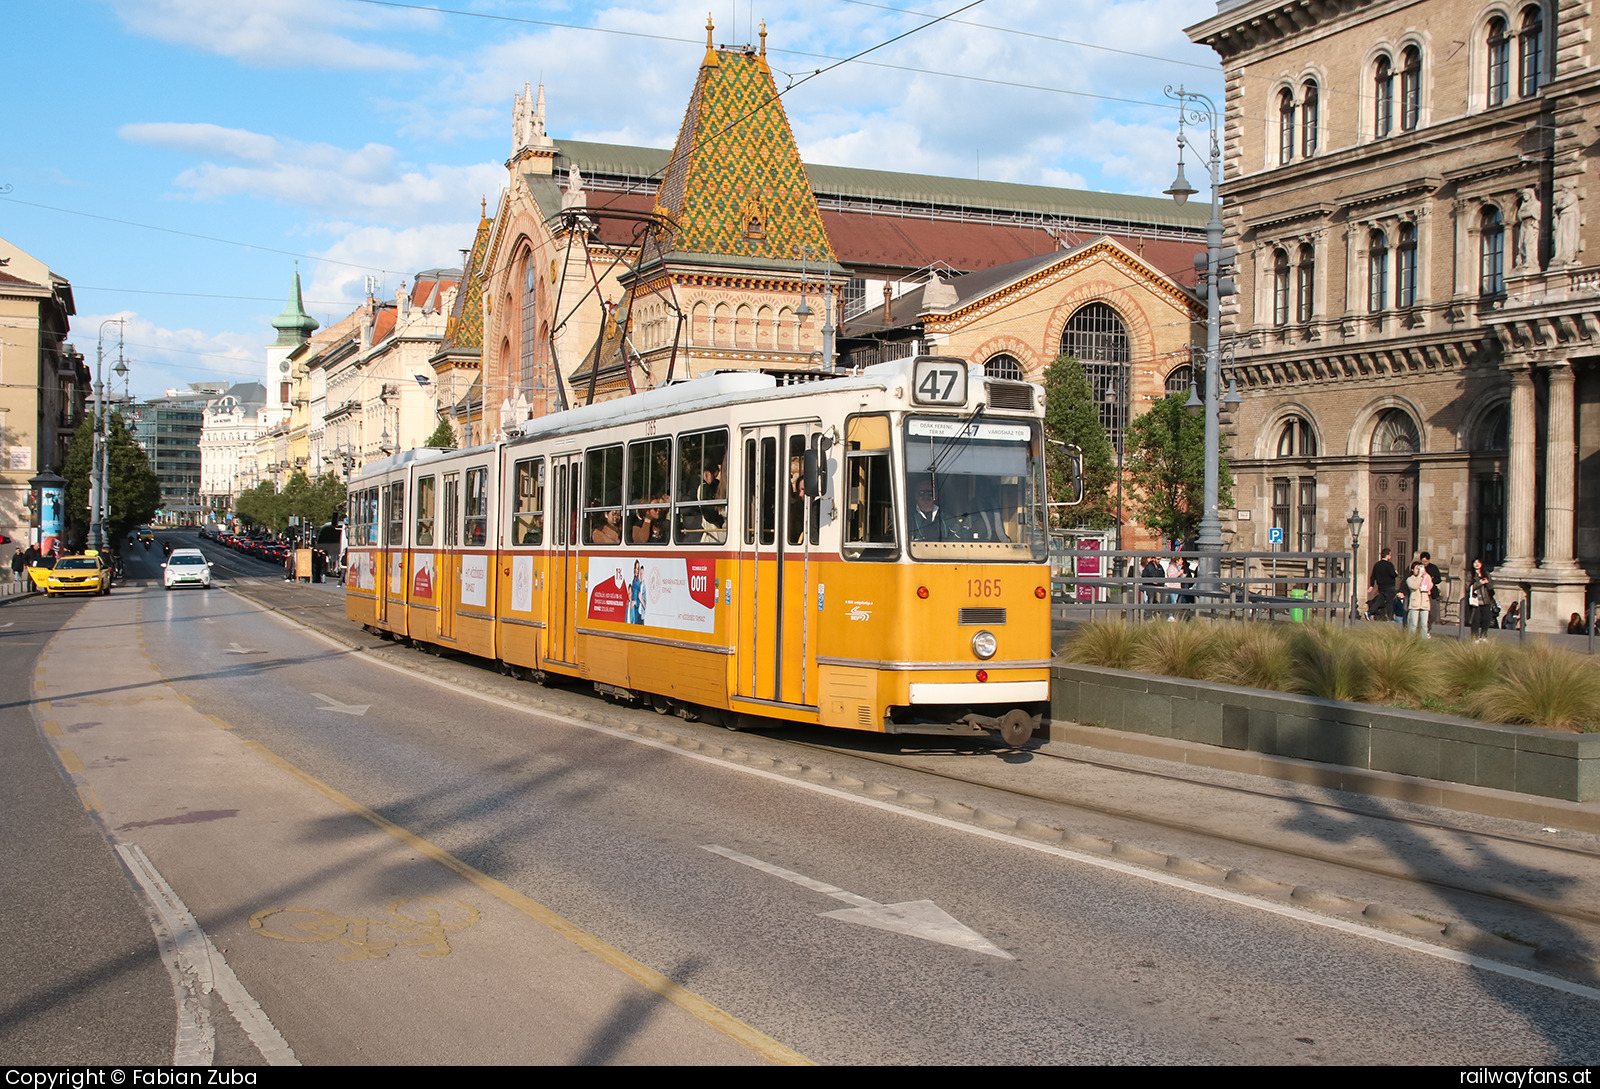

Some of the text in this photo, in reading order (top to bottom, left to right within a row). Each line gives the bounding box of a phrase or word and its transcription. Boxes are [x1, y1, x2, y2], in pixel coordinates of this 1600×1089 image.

[918, 370, 958, 400] 47
[646, 420, 656, 436] 1365
[1271, 530, 1279, 541] P
[691, 575, 707, 592] 0011
[967, 579, 1002, 597] 1365
